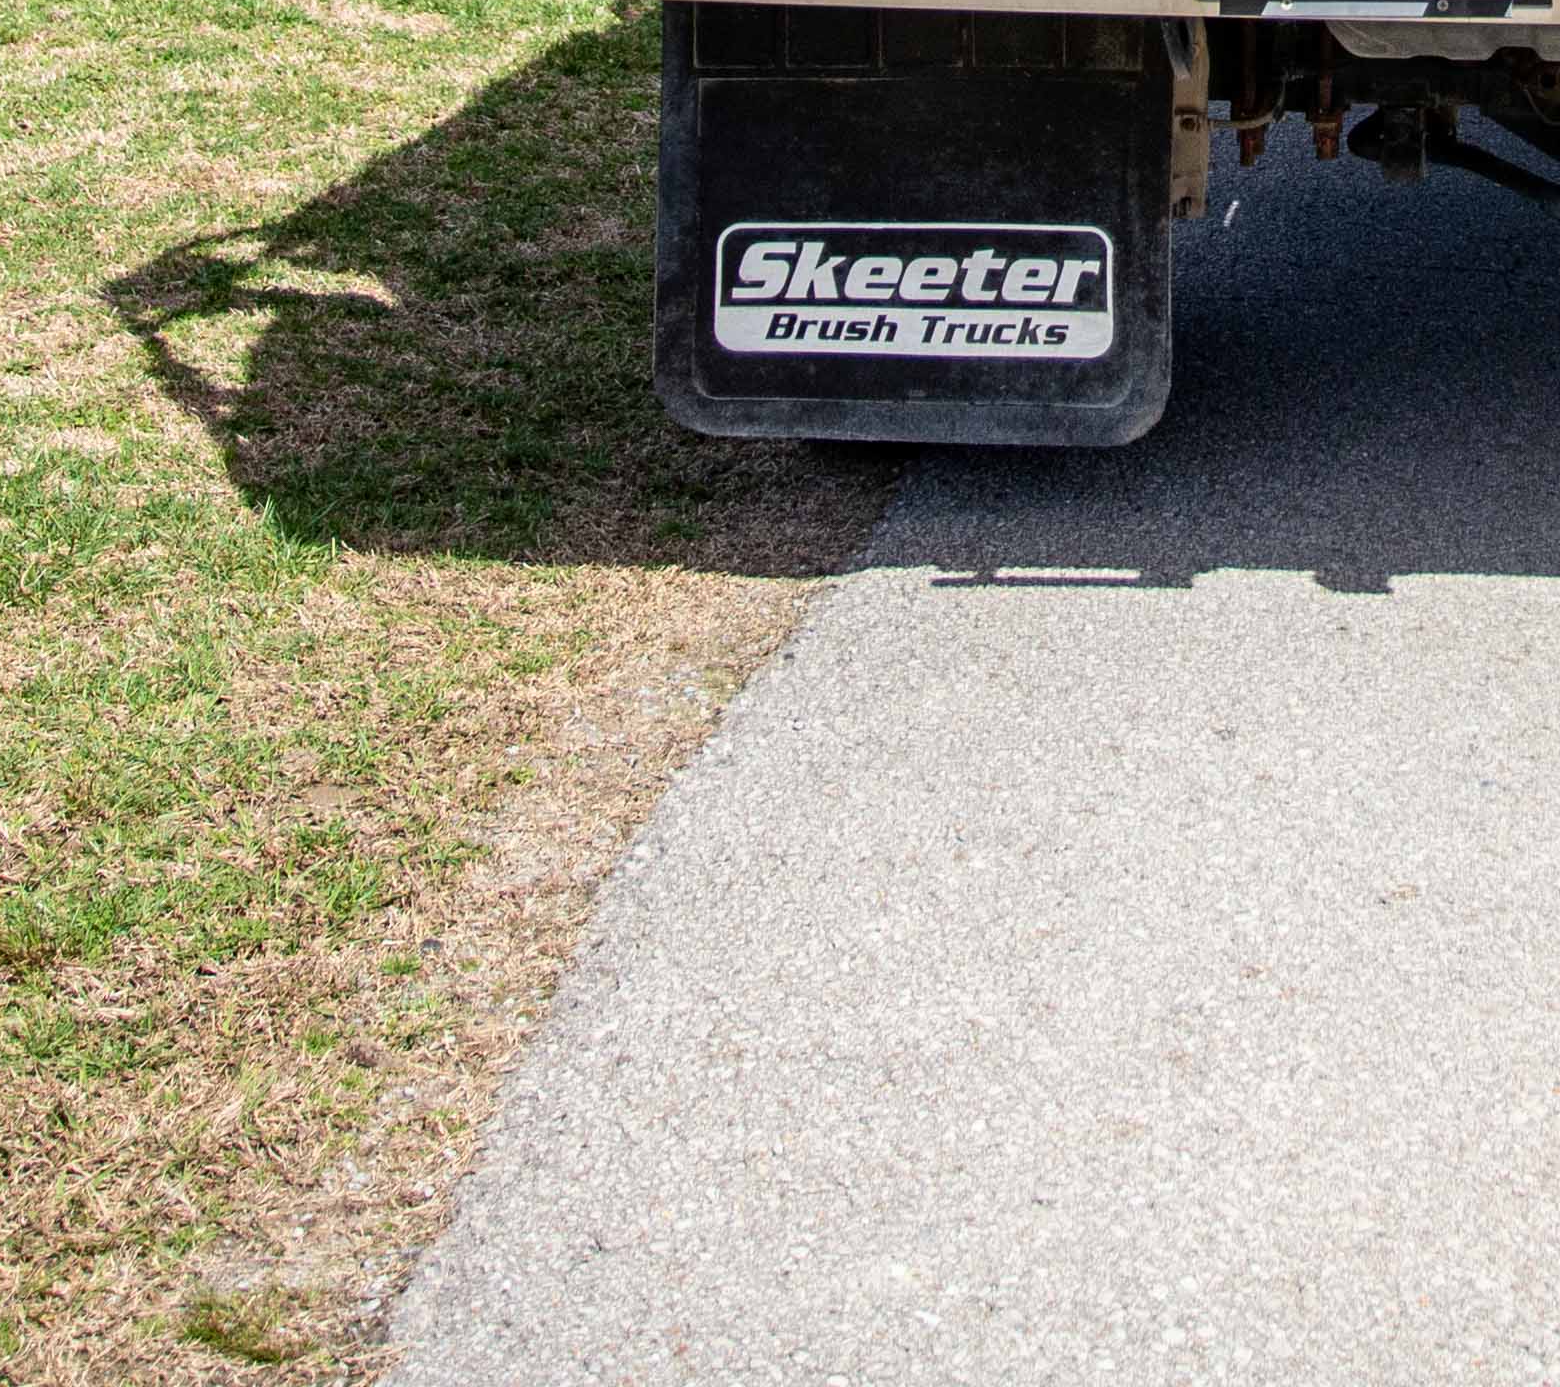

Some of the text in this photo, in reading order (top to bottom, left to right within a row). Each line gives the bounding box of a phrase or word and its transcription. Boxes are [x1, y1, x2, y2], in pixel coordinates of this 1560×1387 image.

[731, 240, 1101, 303] Skeeter
[765, 312, 1070, 346] Brush Trucks
